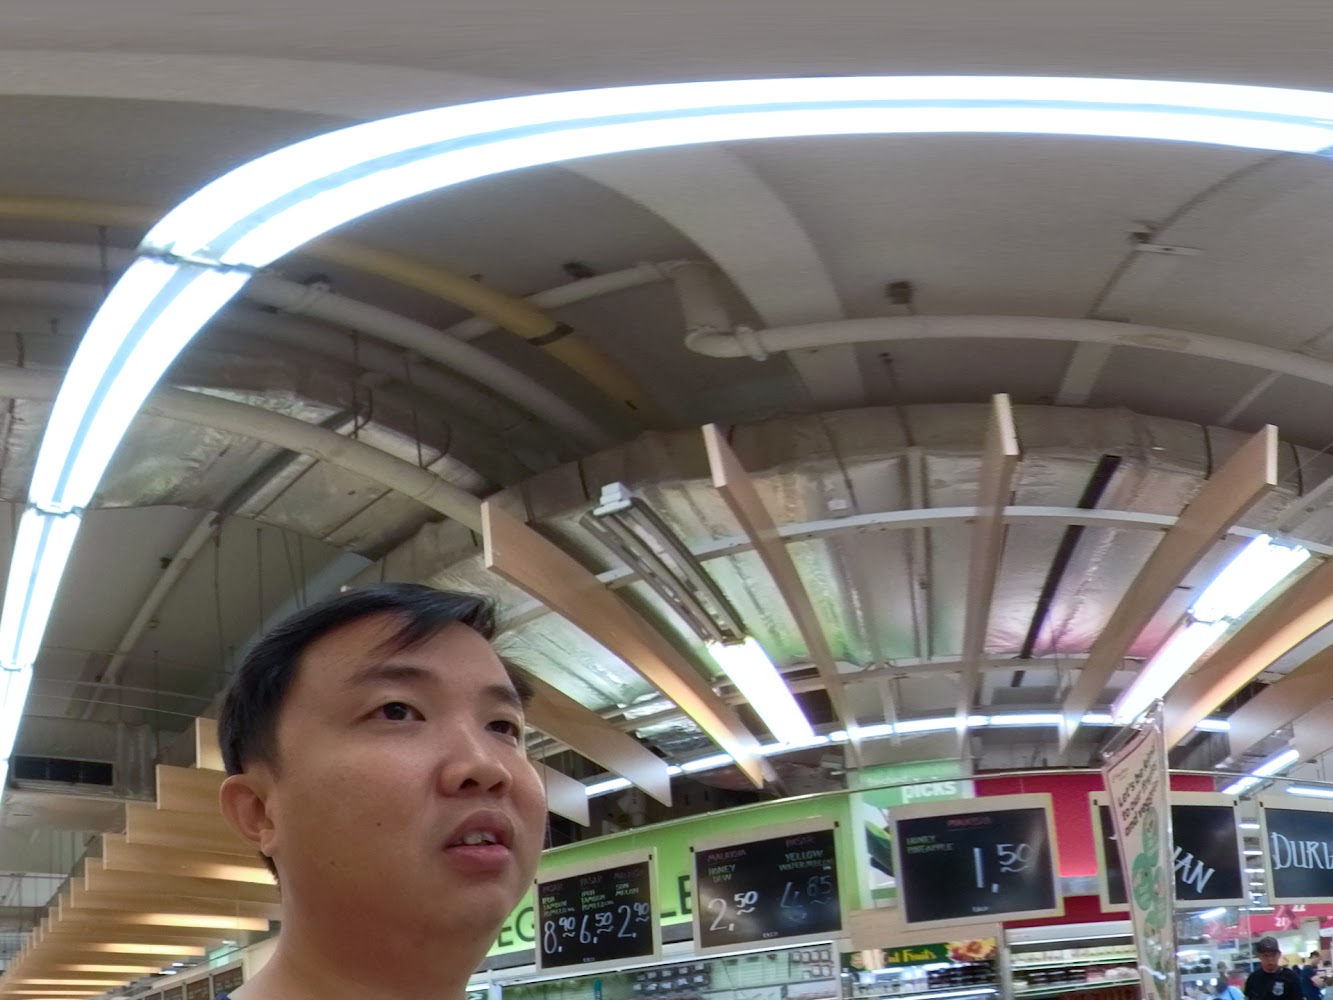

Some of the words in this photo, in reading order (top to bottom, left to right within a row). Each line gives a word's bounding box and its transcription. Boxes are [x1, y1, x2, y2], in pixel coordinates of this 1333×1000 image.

[784, 849, 825, 863] YELLOW
[707, 863, 736, 877] HONEY
[712, 873, 733, 884] DEW
